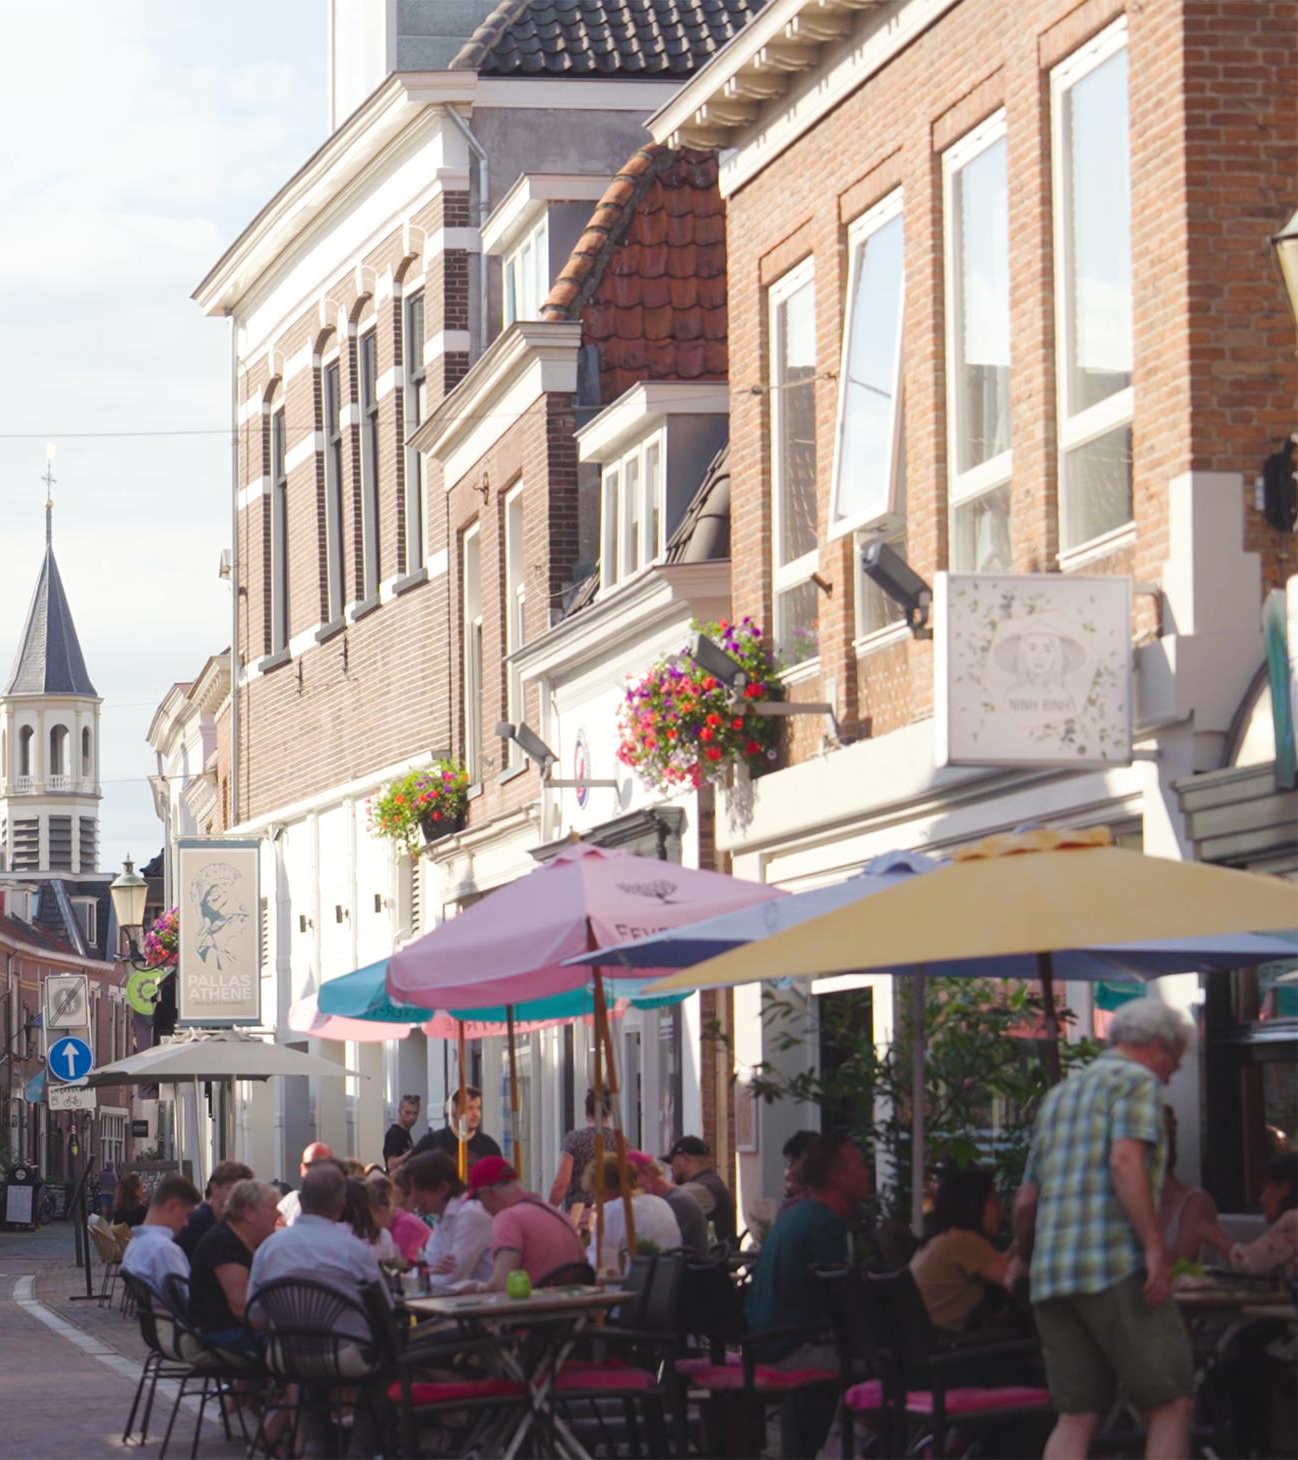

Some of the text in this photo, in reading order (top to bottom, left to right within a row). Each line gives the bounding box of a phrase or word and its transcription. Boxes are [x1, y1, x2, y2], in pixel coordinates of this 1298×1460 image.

[1009, 699, 1039, 711] NINH
[188, 974, 251, 987] PALLAS
[188, 987, 251, 1000] ATHENE
